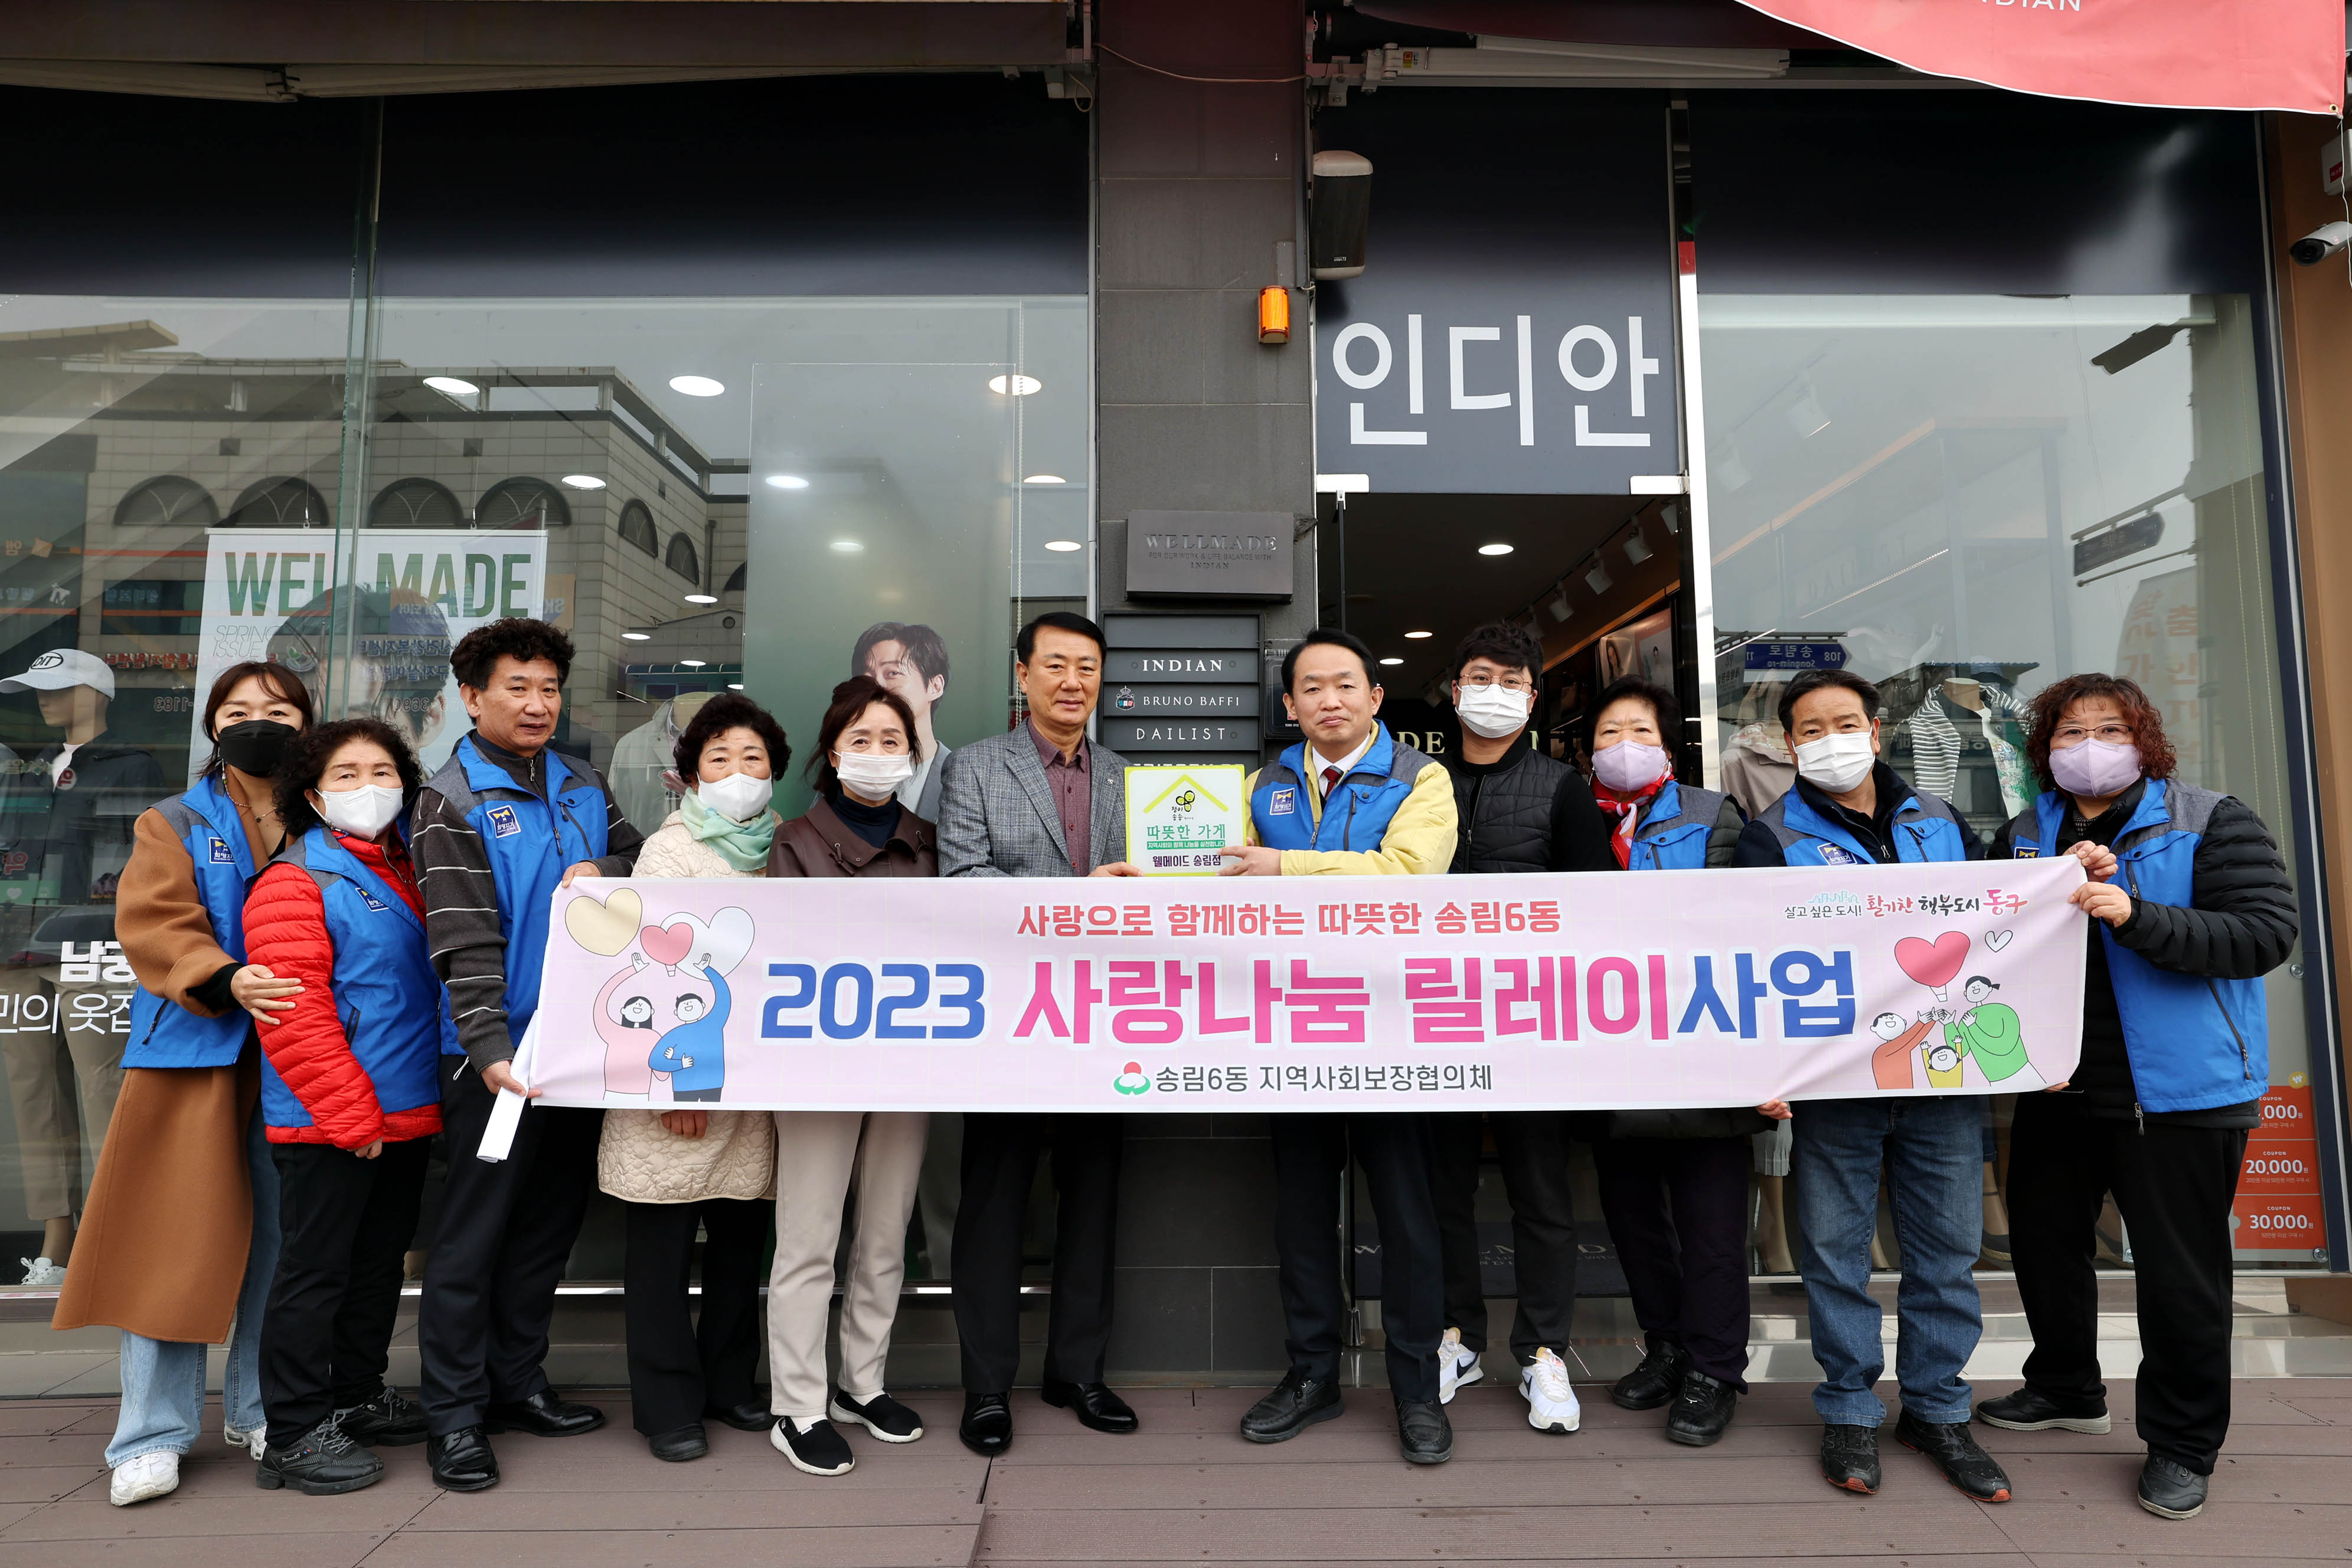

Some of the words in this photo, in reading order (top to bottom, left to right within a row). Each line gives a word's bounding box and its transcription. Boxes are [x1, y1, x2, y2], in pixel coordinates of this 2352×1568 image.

[1333, 314, 1659, 446] 인디안
[1144, 534, 1276, 550] WELLMADE
[225, 552, 532, 618] WELMADE
[213, 641, 261, 657] ISSUE
[1142, 659, 1222, 671] INDIAN
[1144, 697, 1193, 705] BRUNO
[1200, 697, 1239, 705] BAFFI
[1136, 728, 1225, 740] DAILIST
[1147, 825, 1190, 840] 따뜻한
[1198, 824, 1226, 839] 가게
[214, 850, 233, 858] 희망지
[1152, 855, 1190, 867] 웰메이드
[1193, 855, 1221, 866] 송림점
[1867, 894, 1913, 917] 활기찬
[1919, 895, 1979, 916] 행복도시
[1983, 888, 2028, 915] 동구
[1015, 904, 1154, 936] 사랑으로
[1167, 903, 1306, 936] 함께하는
[1318, 902, 1422, 935] 따뜻한
[1435, 900, 1560, 935] 송림6동
[1785, 906, 1807, 919] 살고
[1810, 906, 1832, 919] 싶은
[1835, 905, 1862, 917] 도시!
[760, 962, 984, 1039] 2023
[1012, 959, 1370, 1043] 사랑나눔
[1405, 950, 1856, 1043] 릴레이사업
[1155, 1066, 1248, 1093] 송림6동
[1259, 1063, 1492, 1092] 지역사회보장협의체
[2258, 1105, 2303, 1120] ,000원
